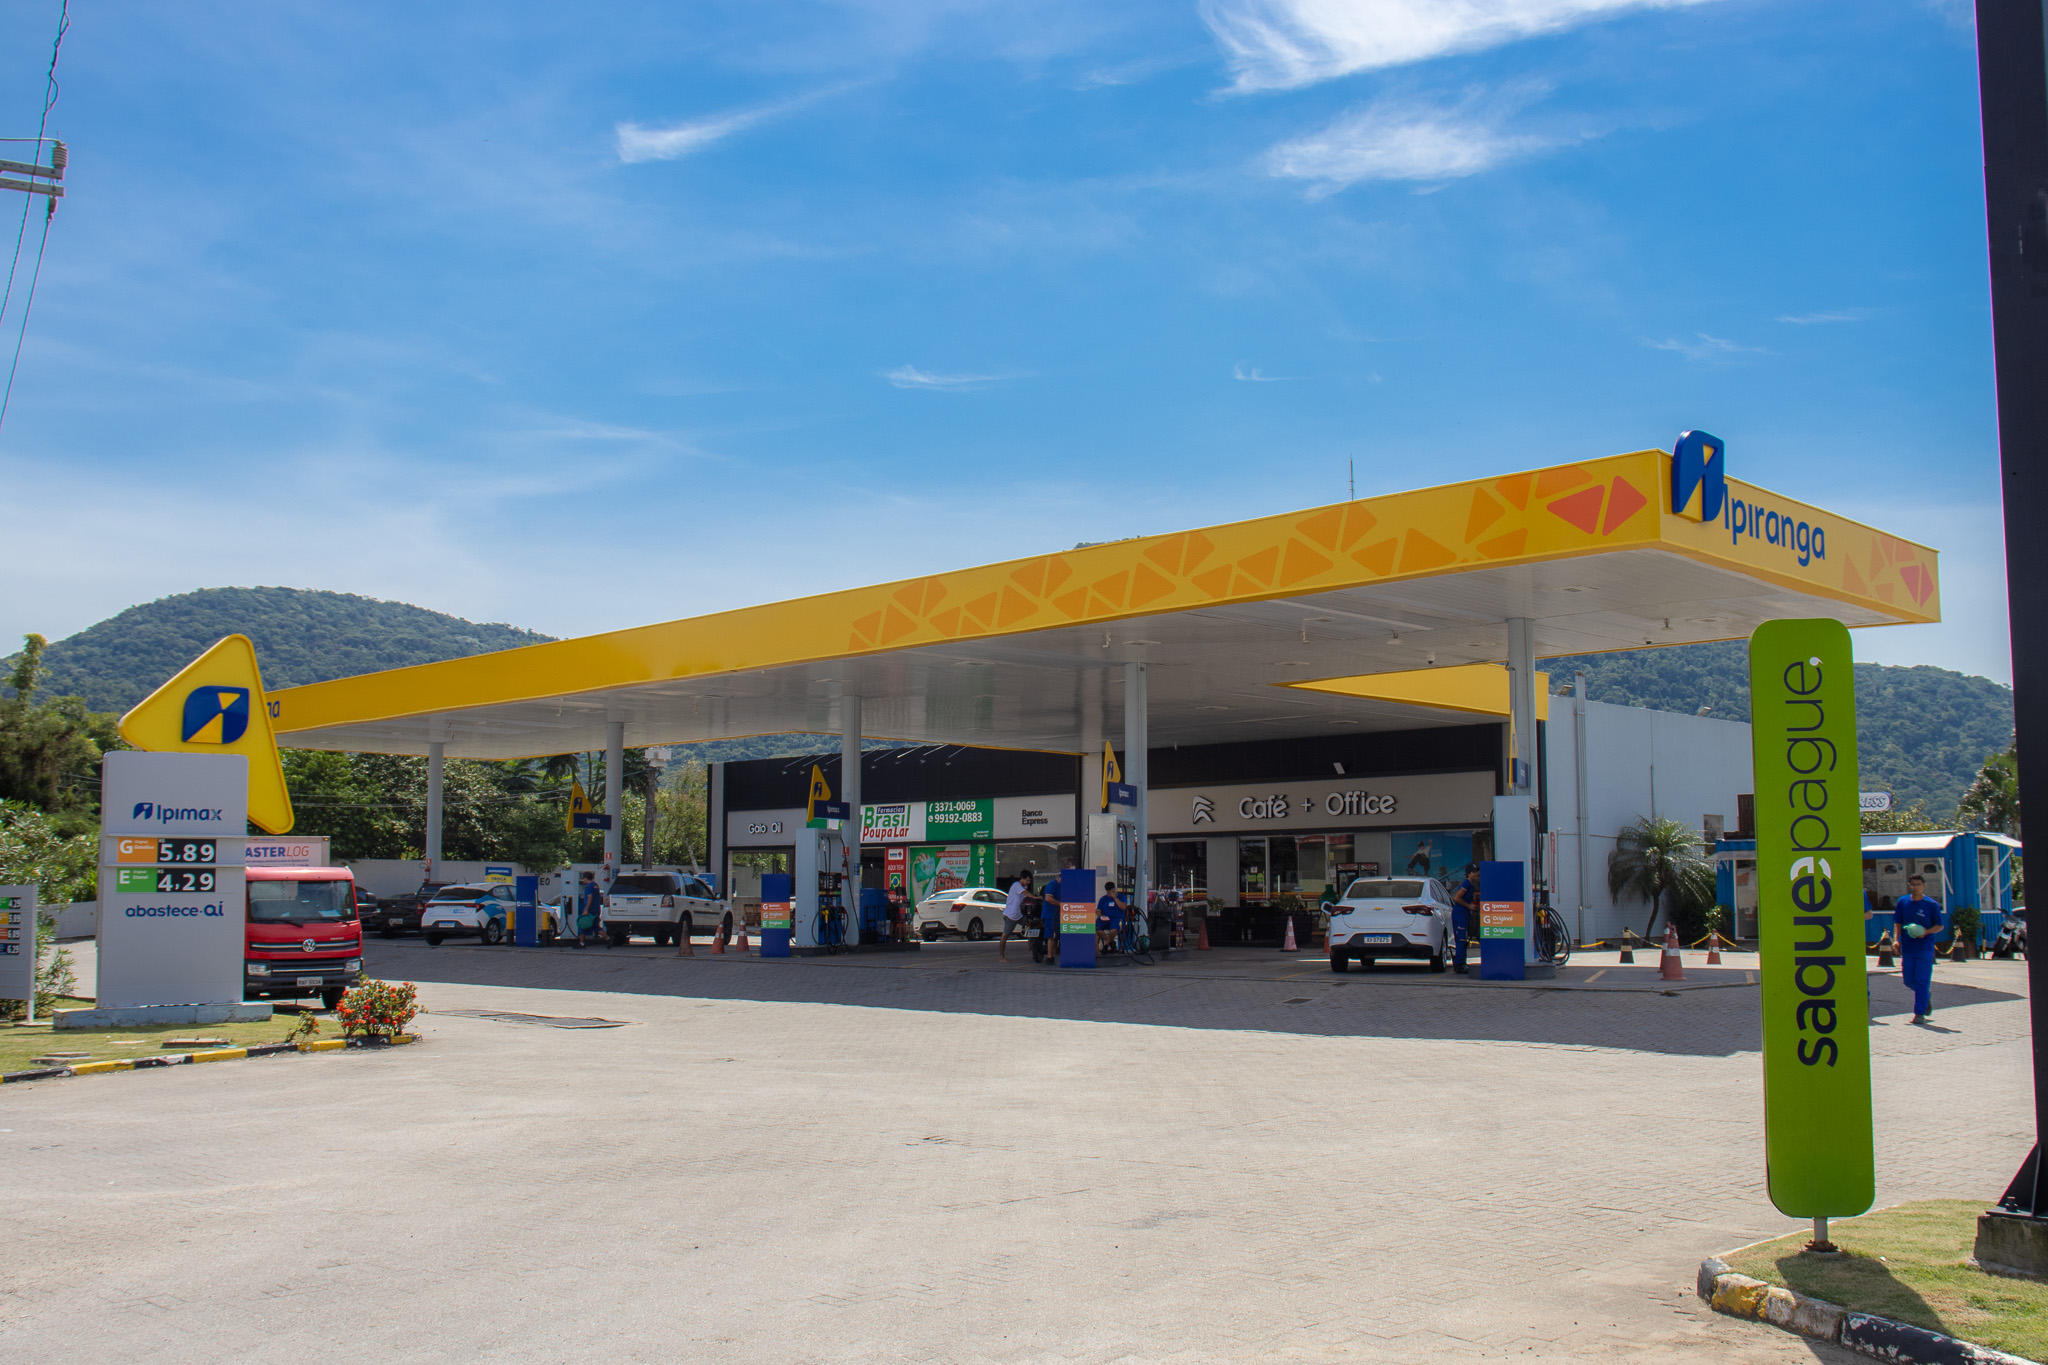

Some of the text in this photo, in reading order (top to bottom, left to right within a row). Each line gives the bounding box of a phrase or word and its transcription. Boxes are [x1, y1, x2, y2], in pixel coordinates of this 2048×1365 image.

[1723, 484, 1825, 566] Ipiranga
[935, 801, 975, 811] 3371-0069
[1239, 795, 1288, 819] Café
[1325, 790, 1396, 815] Office
[157, 805, 222, 824] Ipimax
[865, 805, 911, 827] Brasil
[935, 812, 982, 823] 99192-0883
[1022, 817, 1048, 826] Express
[772, 823, 782, 833] Oil
[120, 840, 133, 853] G
[160, 844, 214, 861] 5,89
[120, 870, 130, 884] E
[158, 873, 214, 891] 4,29
[1484, 927, 1490, 936] E
